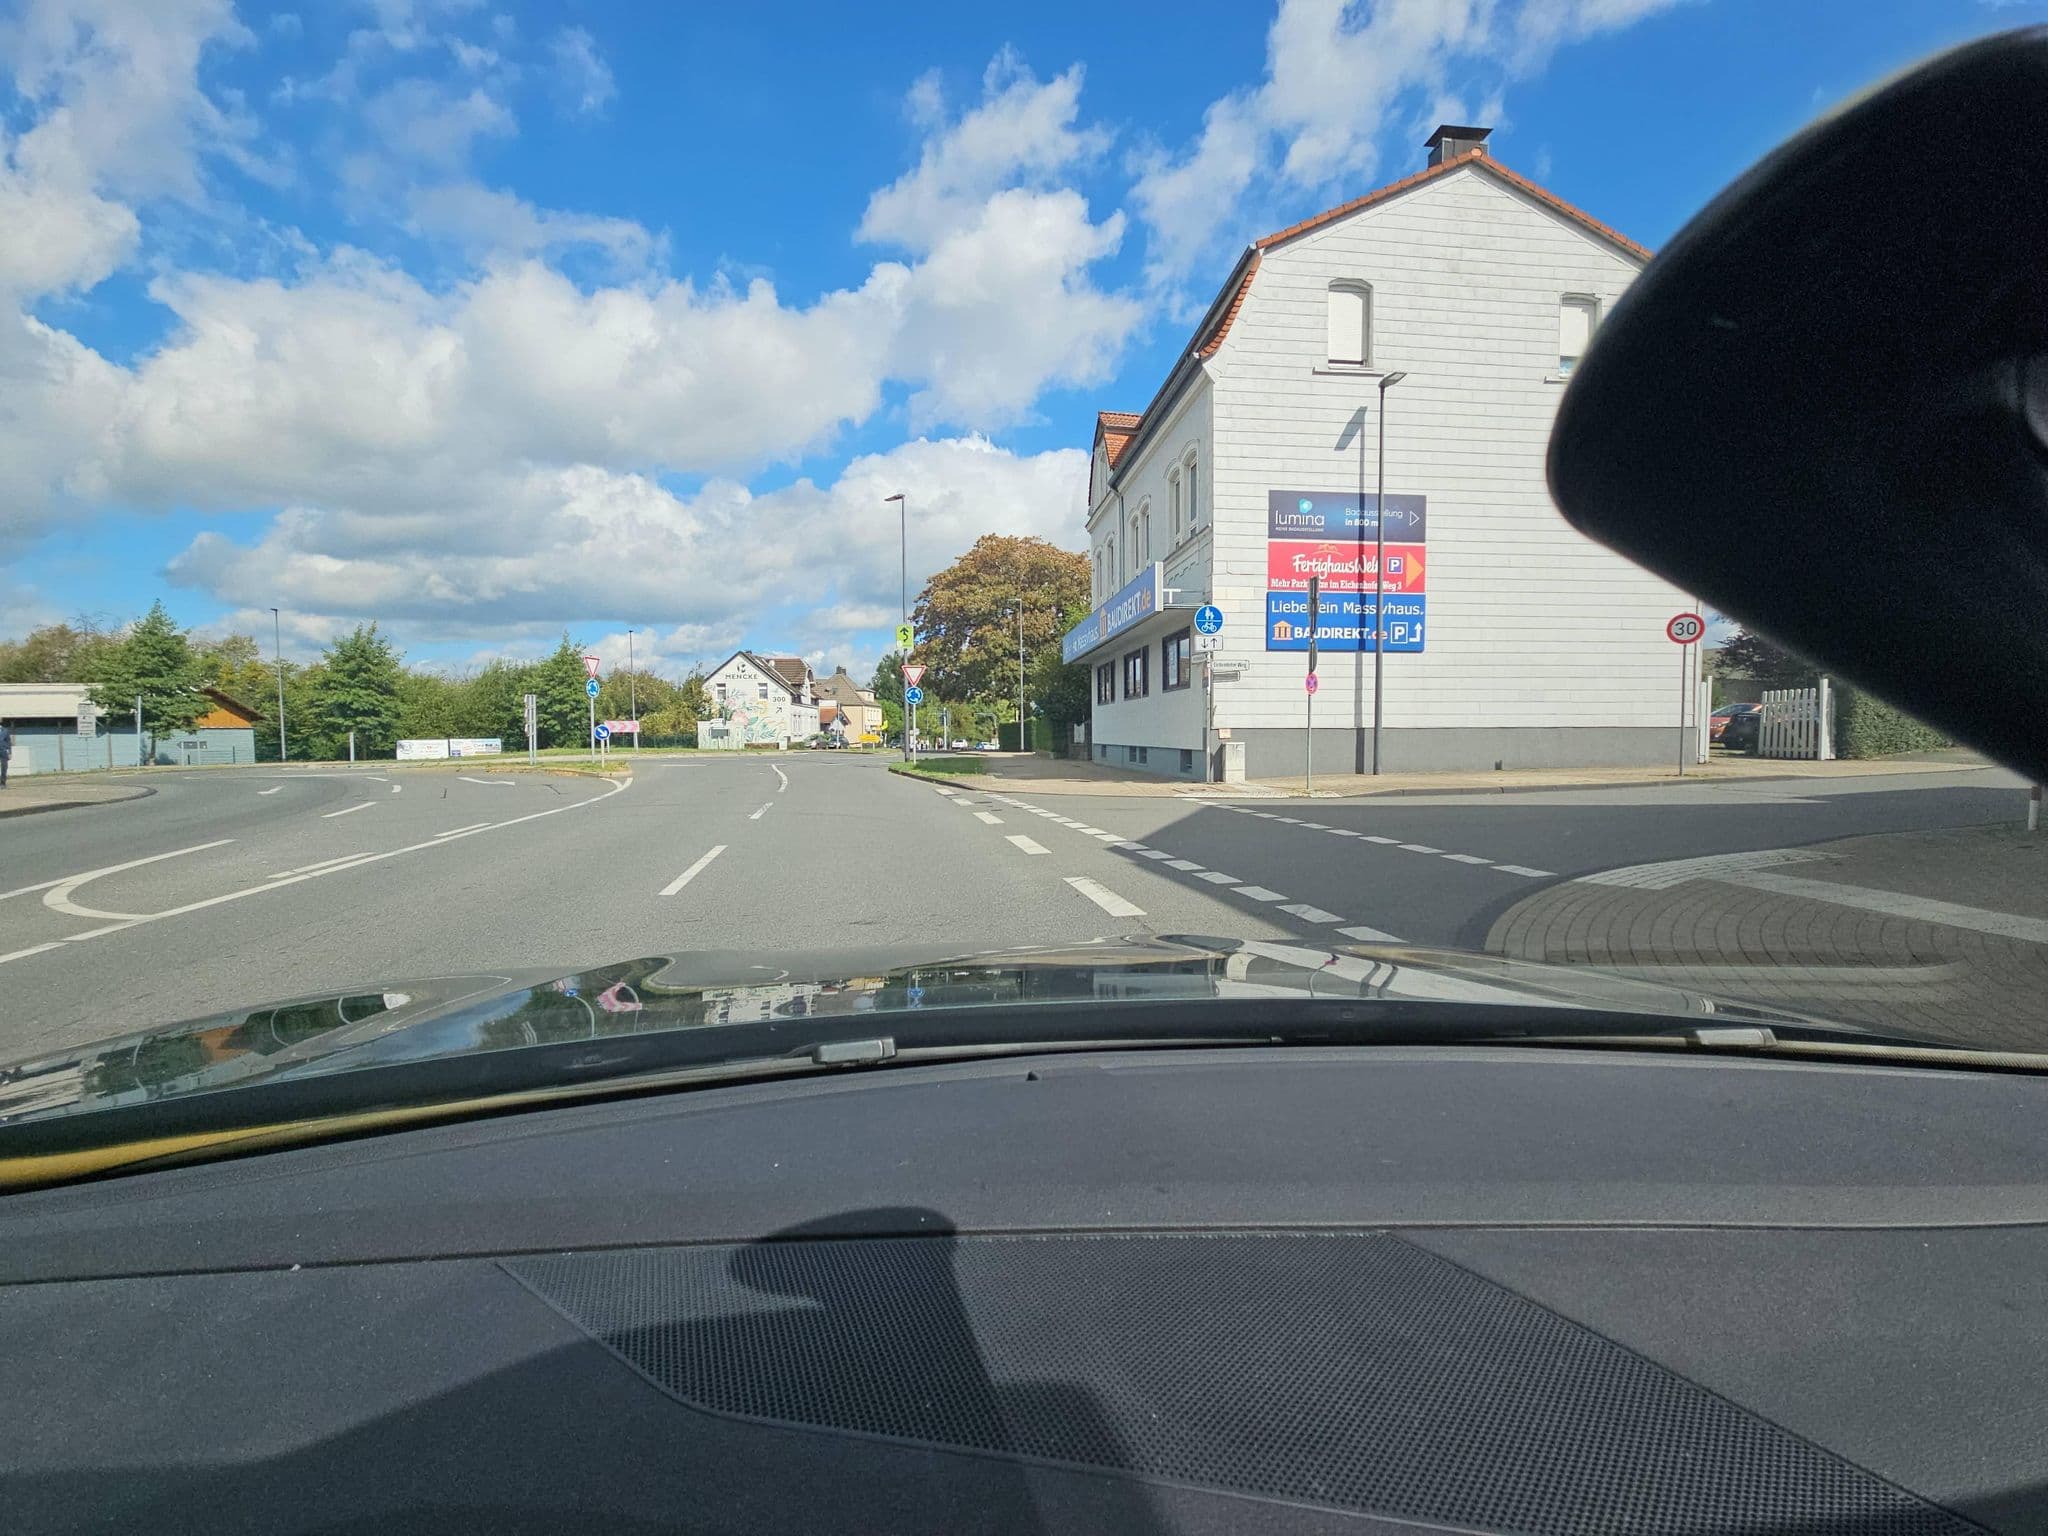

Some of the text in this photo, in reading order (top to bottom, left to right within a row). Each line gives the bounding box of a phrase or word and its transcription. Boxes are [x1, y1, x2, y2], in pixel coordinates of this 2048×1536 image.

[1275, 510, 1325, 525] lumina
[1293, 553, 1379, 579] FertighausWel
[1390, 559, 1400, 571] P
[1271, 578, 1290, 588] Mehr
[1329, 579, 1339, 588] im
[1271, 601, 1424, 615] Liebe ein Massvhaus.
[1394, 627, 1405, 640] P
[1674, 622, 1697, 636] 30
